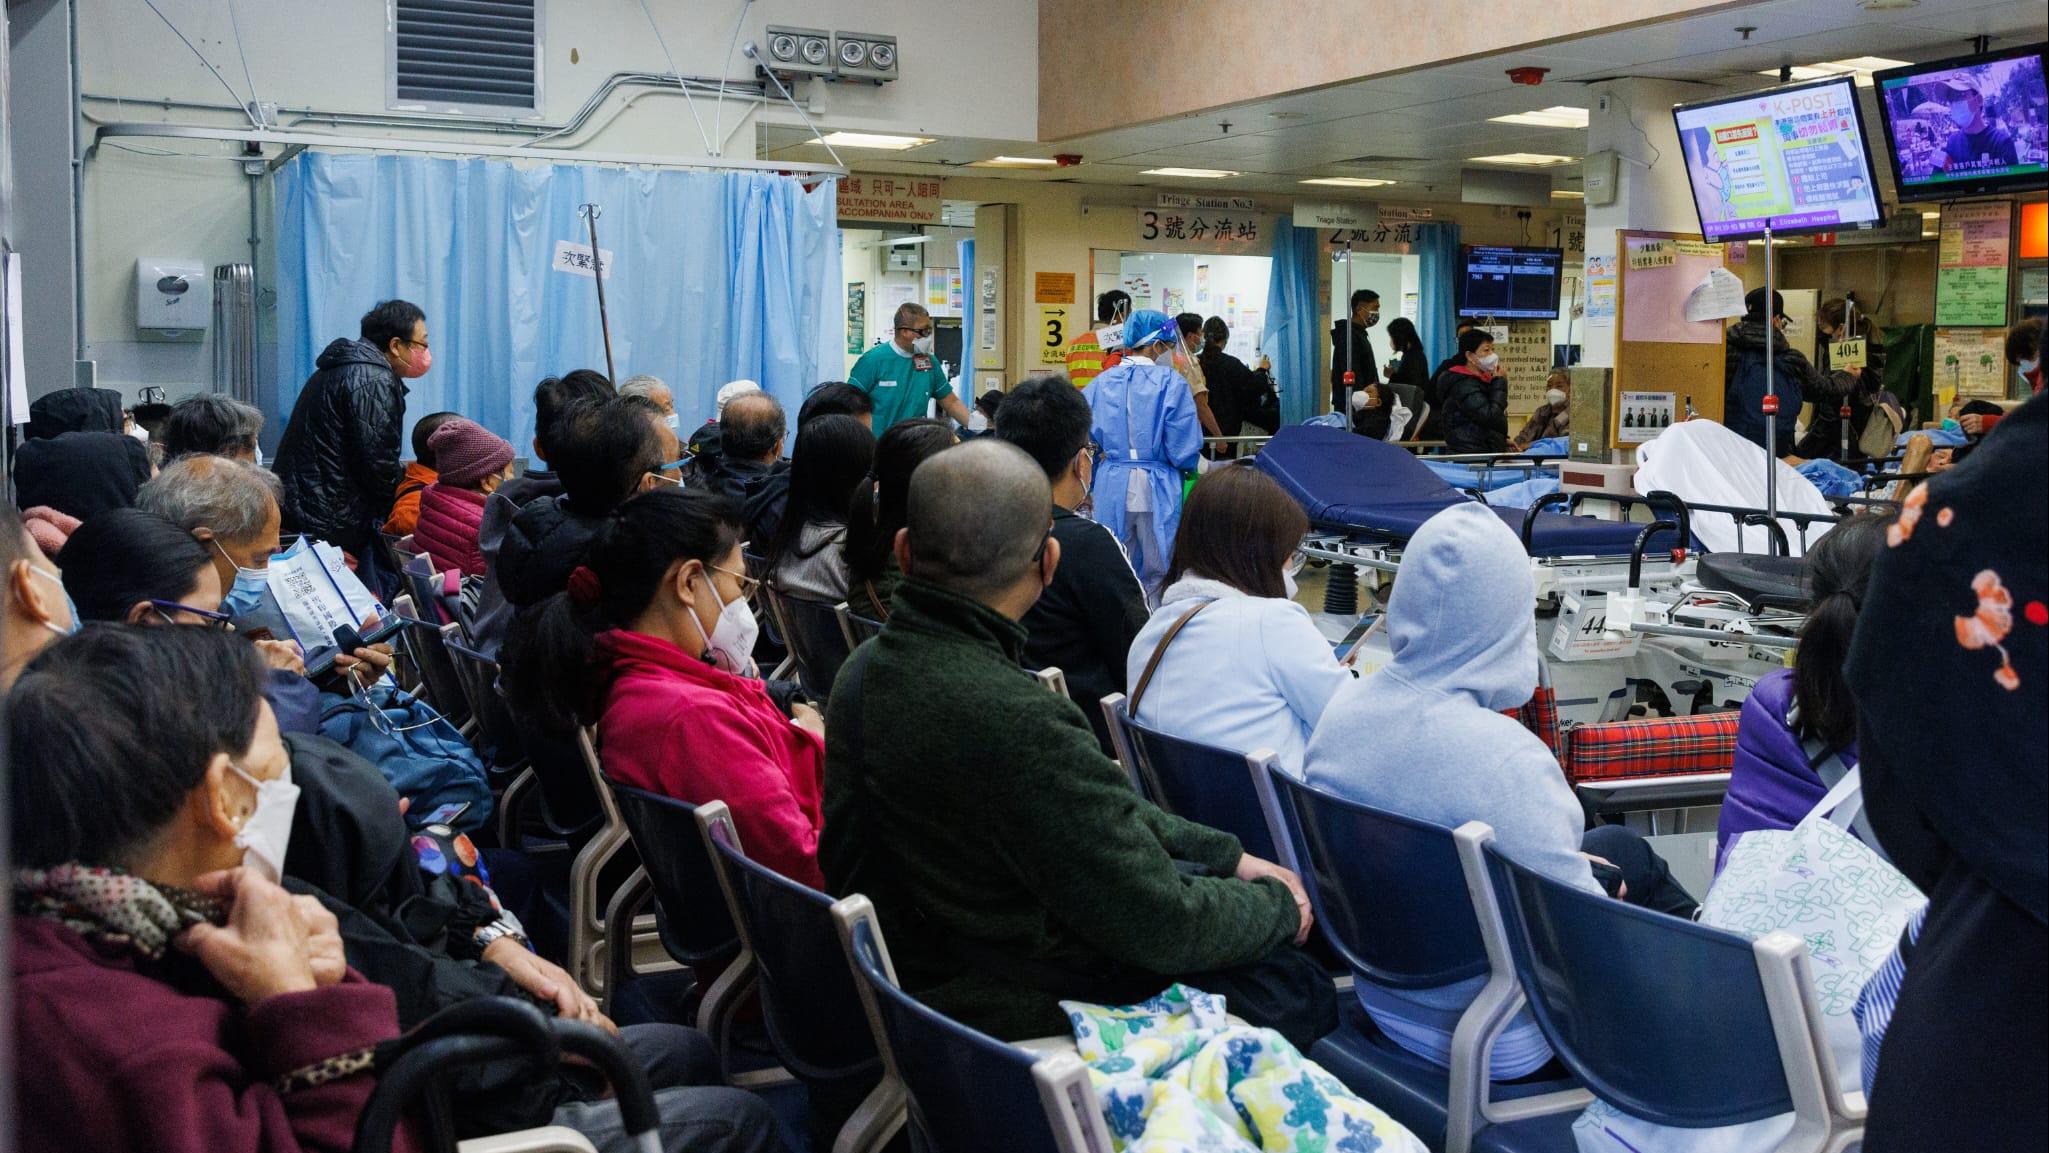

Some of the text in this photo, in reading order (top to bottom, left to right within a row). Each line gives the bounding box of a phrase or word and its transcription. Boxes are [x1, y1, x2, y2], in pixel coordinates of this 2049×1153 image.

[1773, 92, 1833, 115] K-POST
[872, 180, 940, 198] 只可一人陪同
[890, 200, 914, 209] AREA
[1196, 199, 1228, 209] Station
[839, 208, 934, 220] ACCOMPANIAN ONLY
[1143, 211, 1257, 241] 3號分流站
[1046, 320, 1063, 347] 3
[1836, 342, 1859, 358] 404
